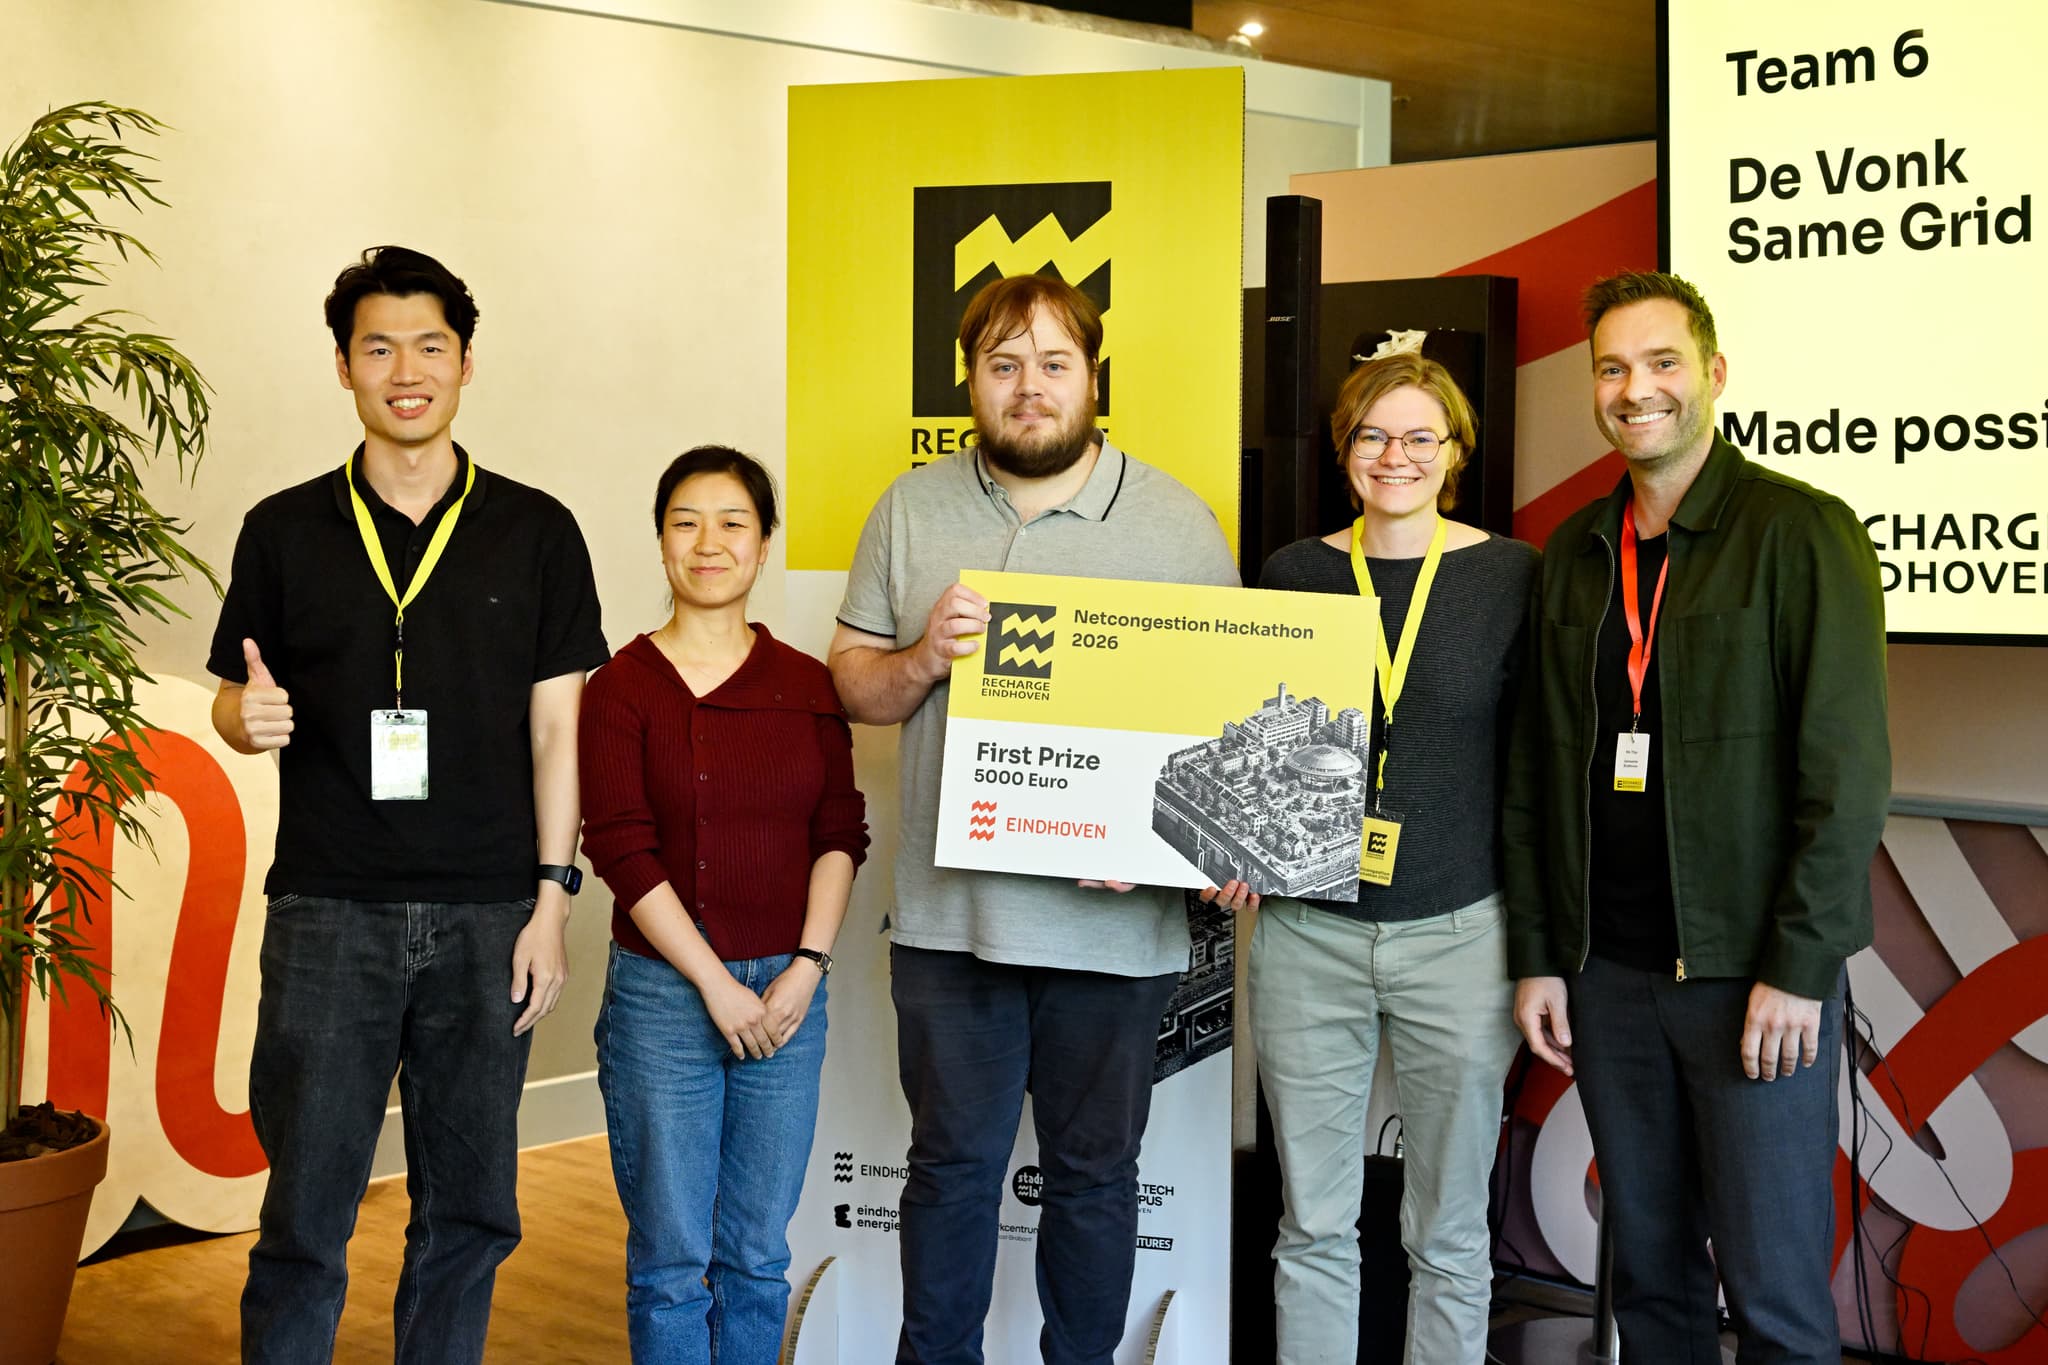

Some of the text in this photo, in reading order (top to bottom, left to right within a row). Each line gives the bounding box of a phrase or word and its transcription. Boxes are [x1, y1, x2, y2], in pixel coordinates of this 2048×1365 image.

[1726, 28, 1930, 96] Team 6
[1729, 138, 1970, 204] De Vonk
[1727, 194, 2032, 264] Same Grid
[1722, 408, 1878, 456] Made
[1863, 512, 2048, 551] CHARG
[1879, 561, 2048, 594] DHOVE
[1074, 609, 1314, 640] Netcongestion Hackathon
[1071, 633, 1119, 650] 2026
[981, 687, 1050, 701] EINDHOVEN
[982, 677, 1051, 692] RECHARGE
[976, 741, 1101, 771] First Prize
[974, 768, 1069, 790] 5000 Euro
[1006, 817, 1107, 840] EINDHOVEN
[860, 1164, 909, 1180] EINDHO
[1138, 1194, 1163, 1207] PUS
[1142, 1184, 1175, 1197] TECH
